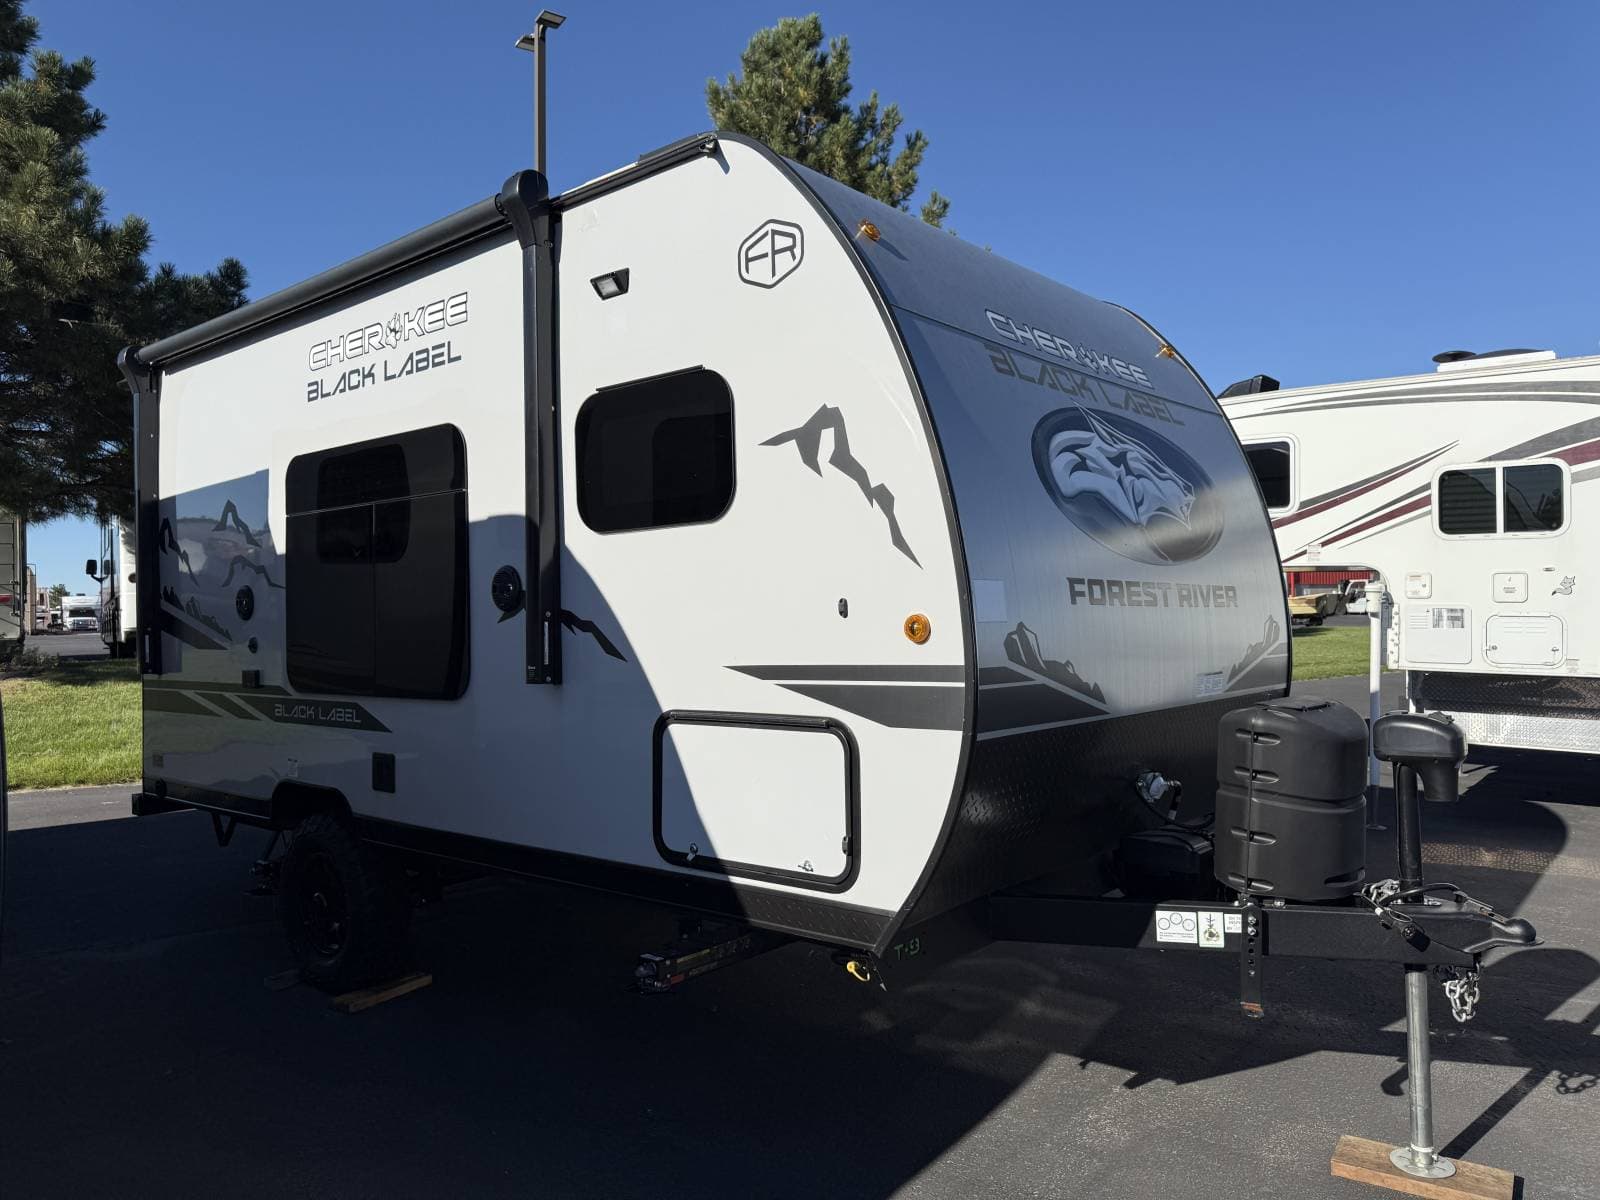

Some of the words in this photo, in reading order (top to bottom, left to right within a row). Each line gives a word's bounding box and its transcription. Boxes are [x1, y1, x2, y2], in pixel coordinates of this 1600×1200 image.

[307, 363, 376, 402] BLACK
[383, 341, 462, 381] LABEL
[983, 342, 1098, 403] BLACK
[1096, 379, 1186, 426] LABEL
[1066, 577, 1172, 608] FOREST
[1175, 583, 1239, 608] RIVER
[274, 703, 315, 719] BLACK
[318, 706, 362, 723] LABEL
